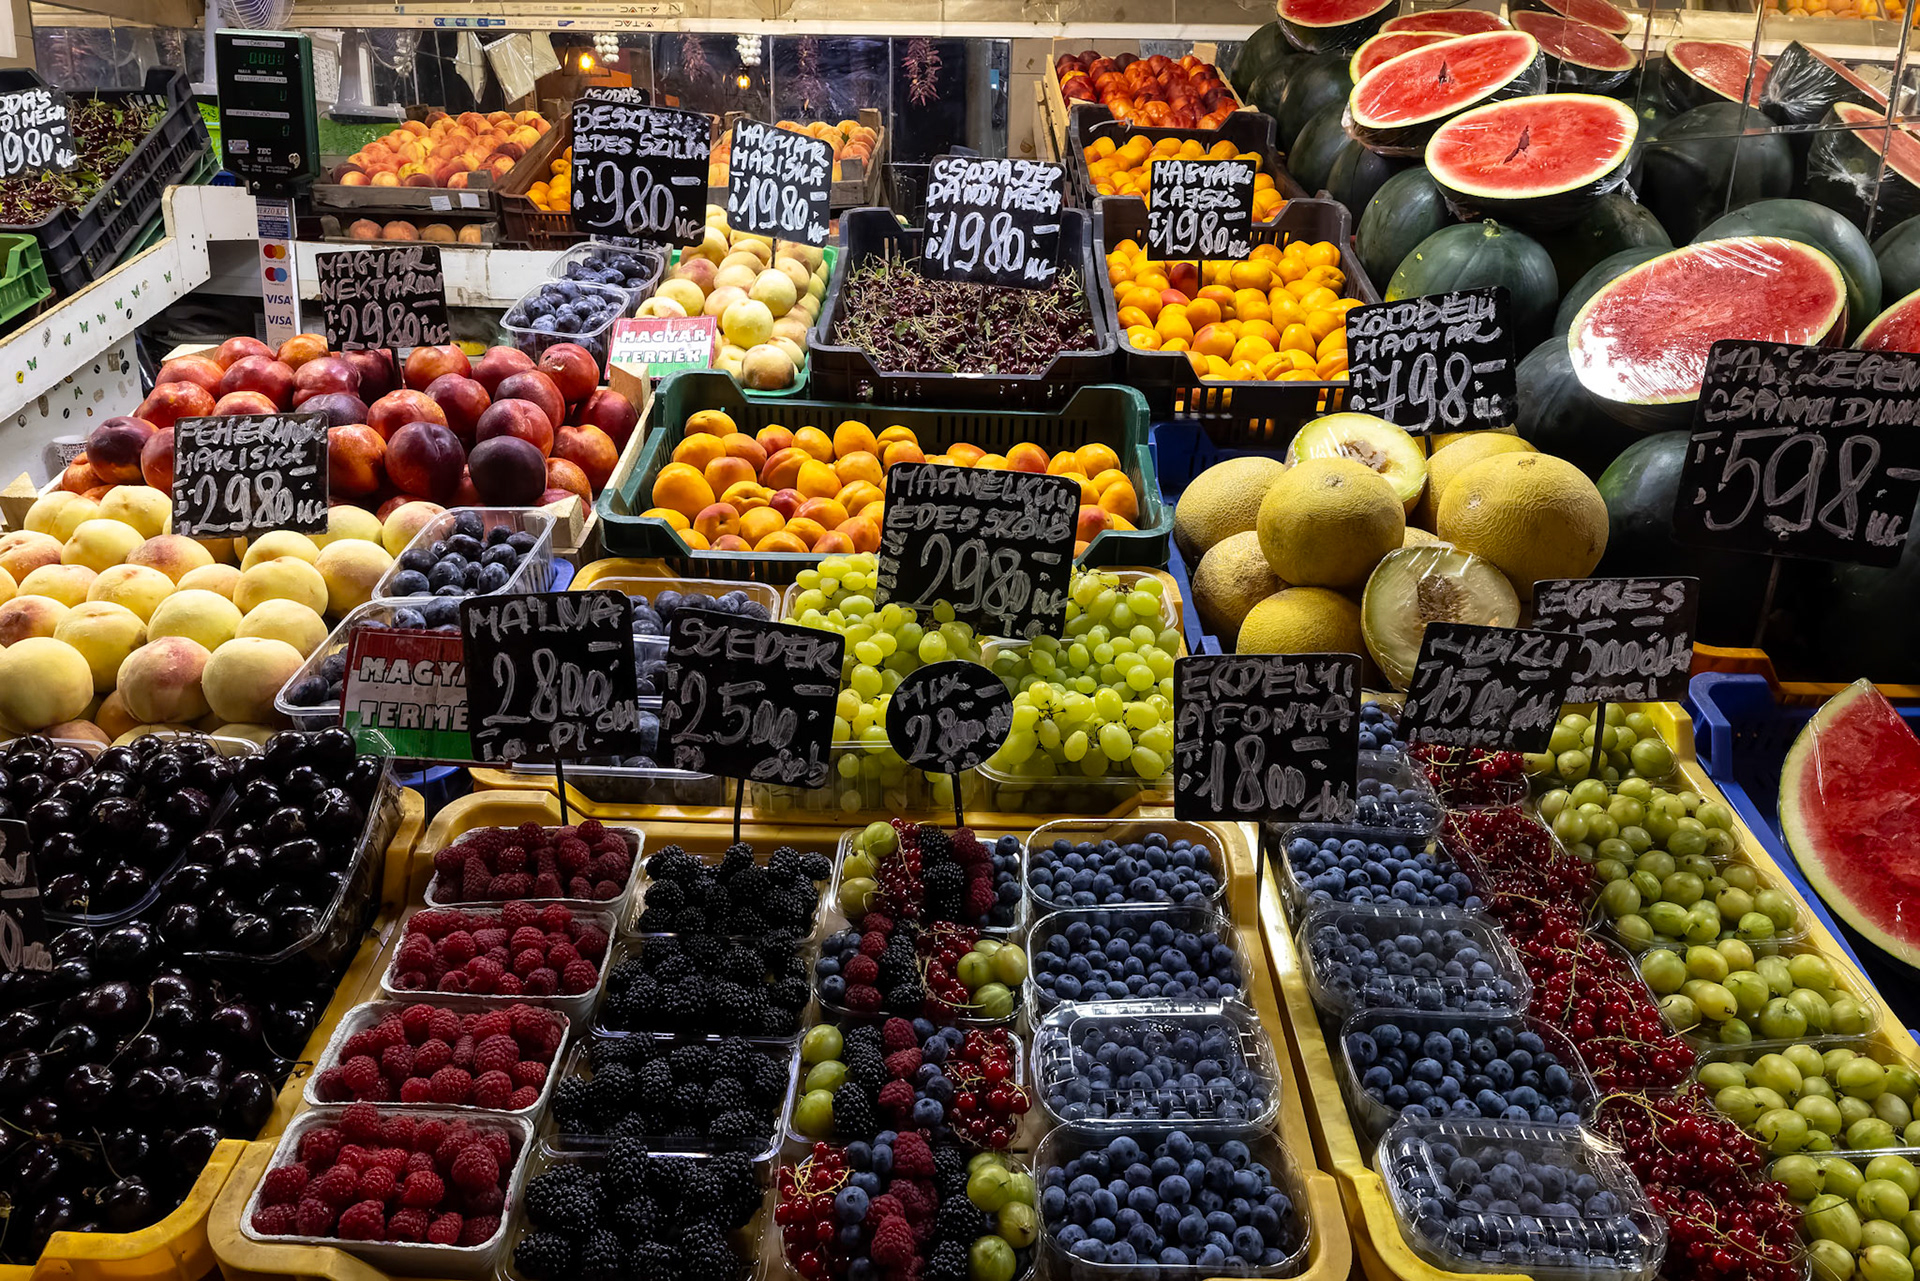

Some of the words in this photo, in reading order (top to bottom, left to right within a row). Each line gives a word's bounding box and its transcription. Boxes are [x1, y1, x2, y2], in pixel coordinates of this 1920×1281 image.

[737, 121, 830, 168] MAGYAR
[318, 246, 437, 279] MAGYAR
[265, 293, 292, 305] VISA
[267, 314, 292, 326] VISA
[619, 348, 702, 364] TERMÉK
[1355, 321, 1502, 362] MAGYAR
[887, 498, 981, 533] ÉDES
[468, 594, 625, 643] MÁLNA
[670, 617, 842, 679] SZEDER
[896, 672, 971, 712] MIX
[1181, 656, 1354, 700] ERDÉLYI
